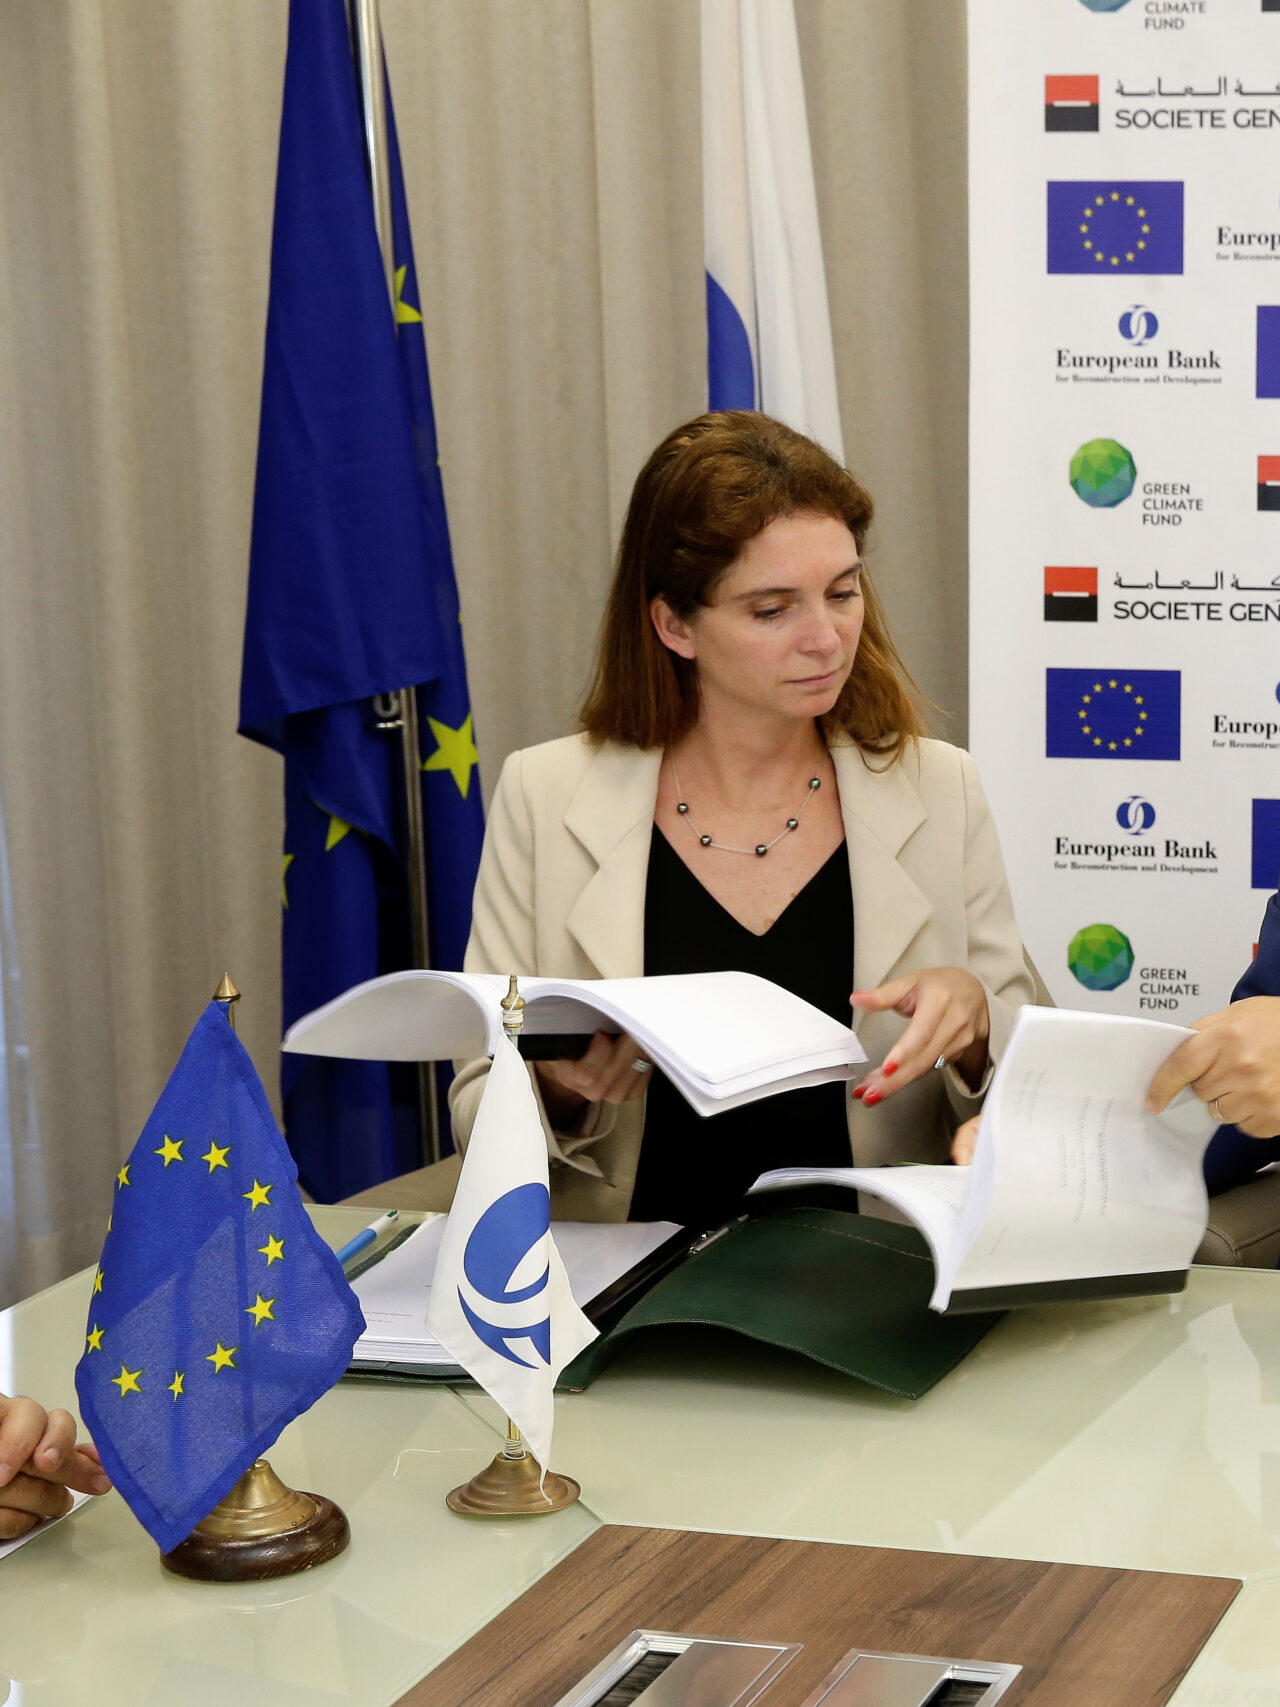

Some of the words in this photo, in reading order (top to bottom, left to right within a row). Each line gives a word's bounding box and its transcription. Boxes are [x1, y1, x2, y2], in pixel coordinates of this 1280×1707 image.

[1145, 1, 1206, 14] CLIMATE
[1144, 18, 1185, 30] FUND
[1116, 109, 1226, 129] SOCIETE
[1216, 252, 1229, 261] for
[1056, 350, 1158, 371] European
[1168, 350, 1220, 368] Bank
[1056, 374, 1069, 383] for
[1072, 374, 1140, 383] Reconstruction
[1144, 374, 1160, 383] and
[1163, 374, 1222, 386] Development
[1143, 483, 1190, 495] GREEN
[1143, 498, 1203, 511] CLIMATE
[1142, 514, 1182, 526] FUND
[1114, 601, 1222, 621] SOCIETE
[1212, 740, 1226, 748] for
[1055, 837, 1155, 861] European
[1165, 840, 1217, 859] Bank
[1054, 861, 1067, 870] for
[1071, 862, 1138, 872] Reconstruction
[1141, 864, 1157, 872] and
[1160, 864, 1218, 875] Development
[1140, 968, 1187, 980] GREEN
[1140, 983, 1200, 995] CLIMATE
[1140, 998, 1179, 1010] FUND
